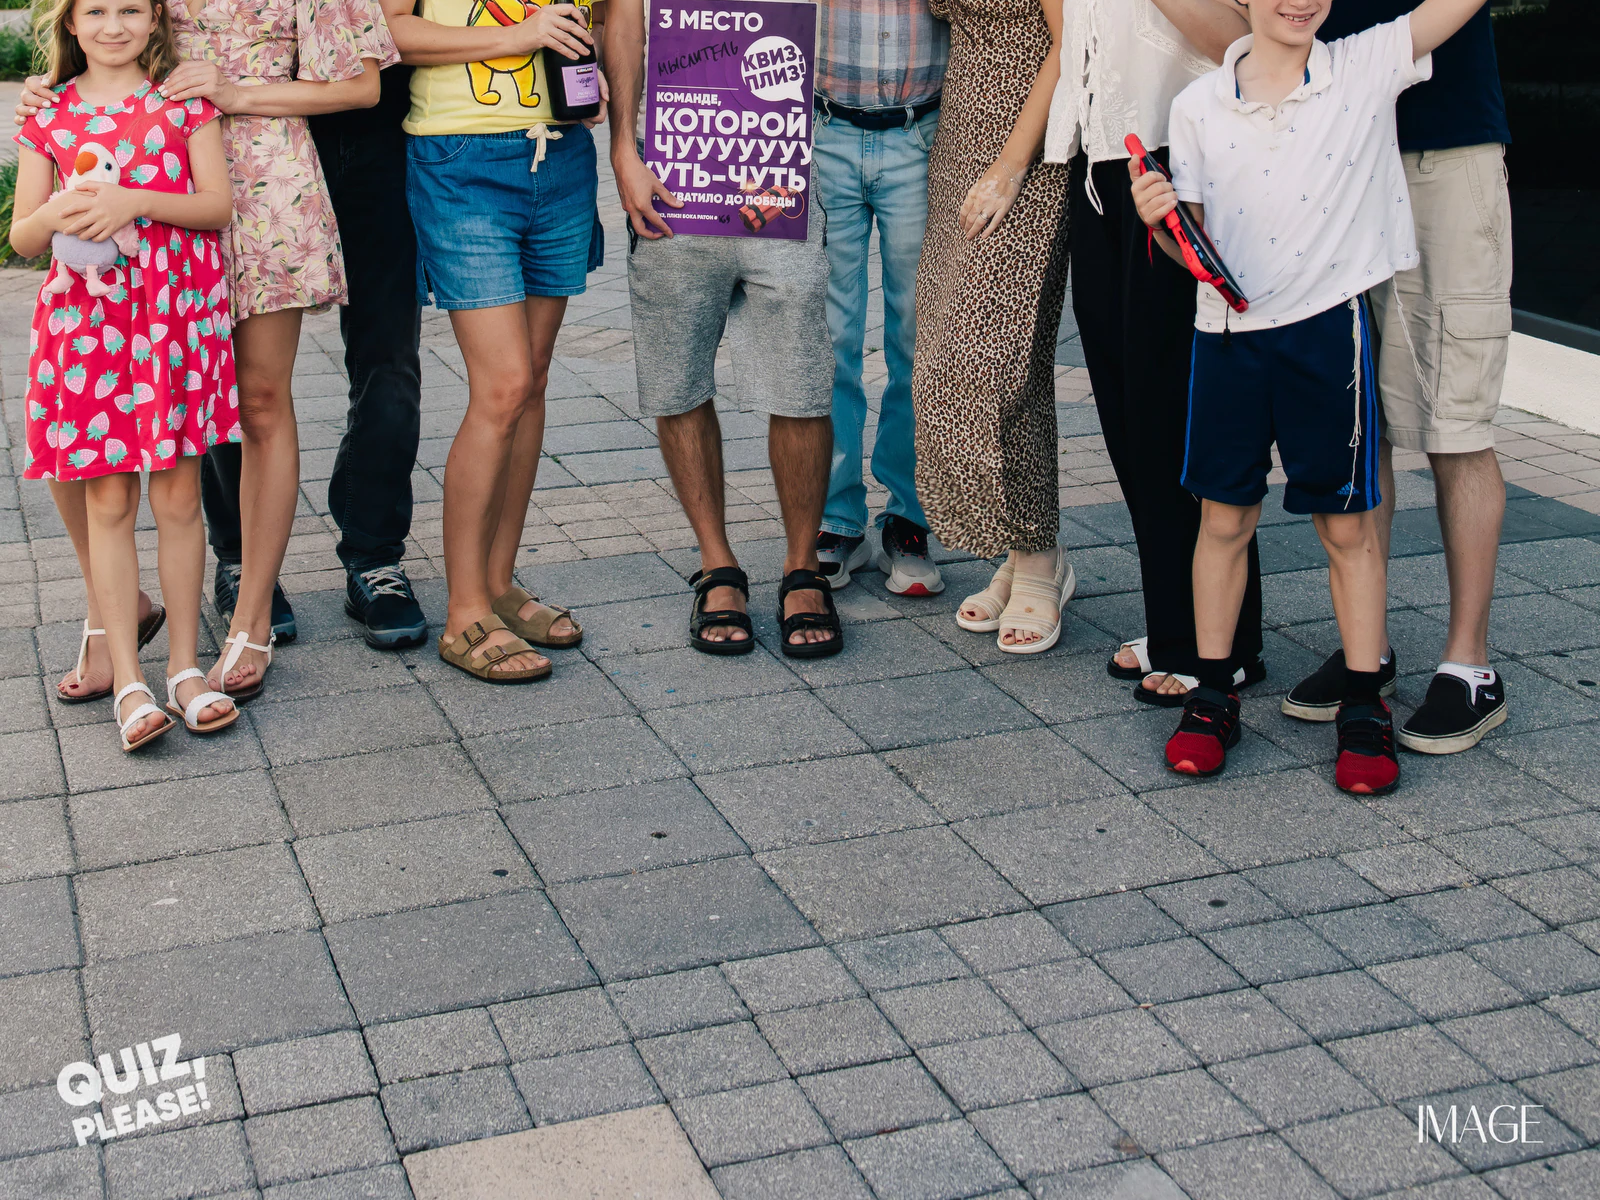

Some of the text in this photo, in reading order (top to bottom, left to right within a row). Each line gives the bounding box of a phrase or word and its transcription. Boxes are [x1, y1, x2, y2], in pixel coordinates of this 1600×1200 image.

[658, 9, 764, 32] 3 МЕСТО
[657, 41, 739, 77] МЫСЛИТЕЛЬ
[744, 62, 806, 90] ПЛИЗ!
[656, 91, 722, 106] КОМАНДЕ,
[655, 107, 807, 138] КОТОРОЙ
[725, 194, 743, 206] ДО
[745, 195, 796, 208] ПОБЕДЫ
